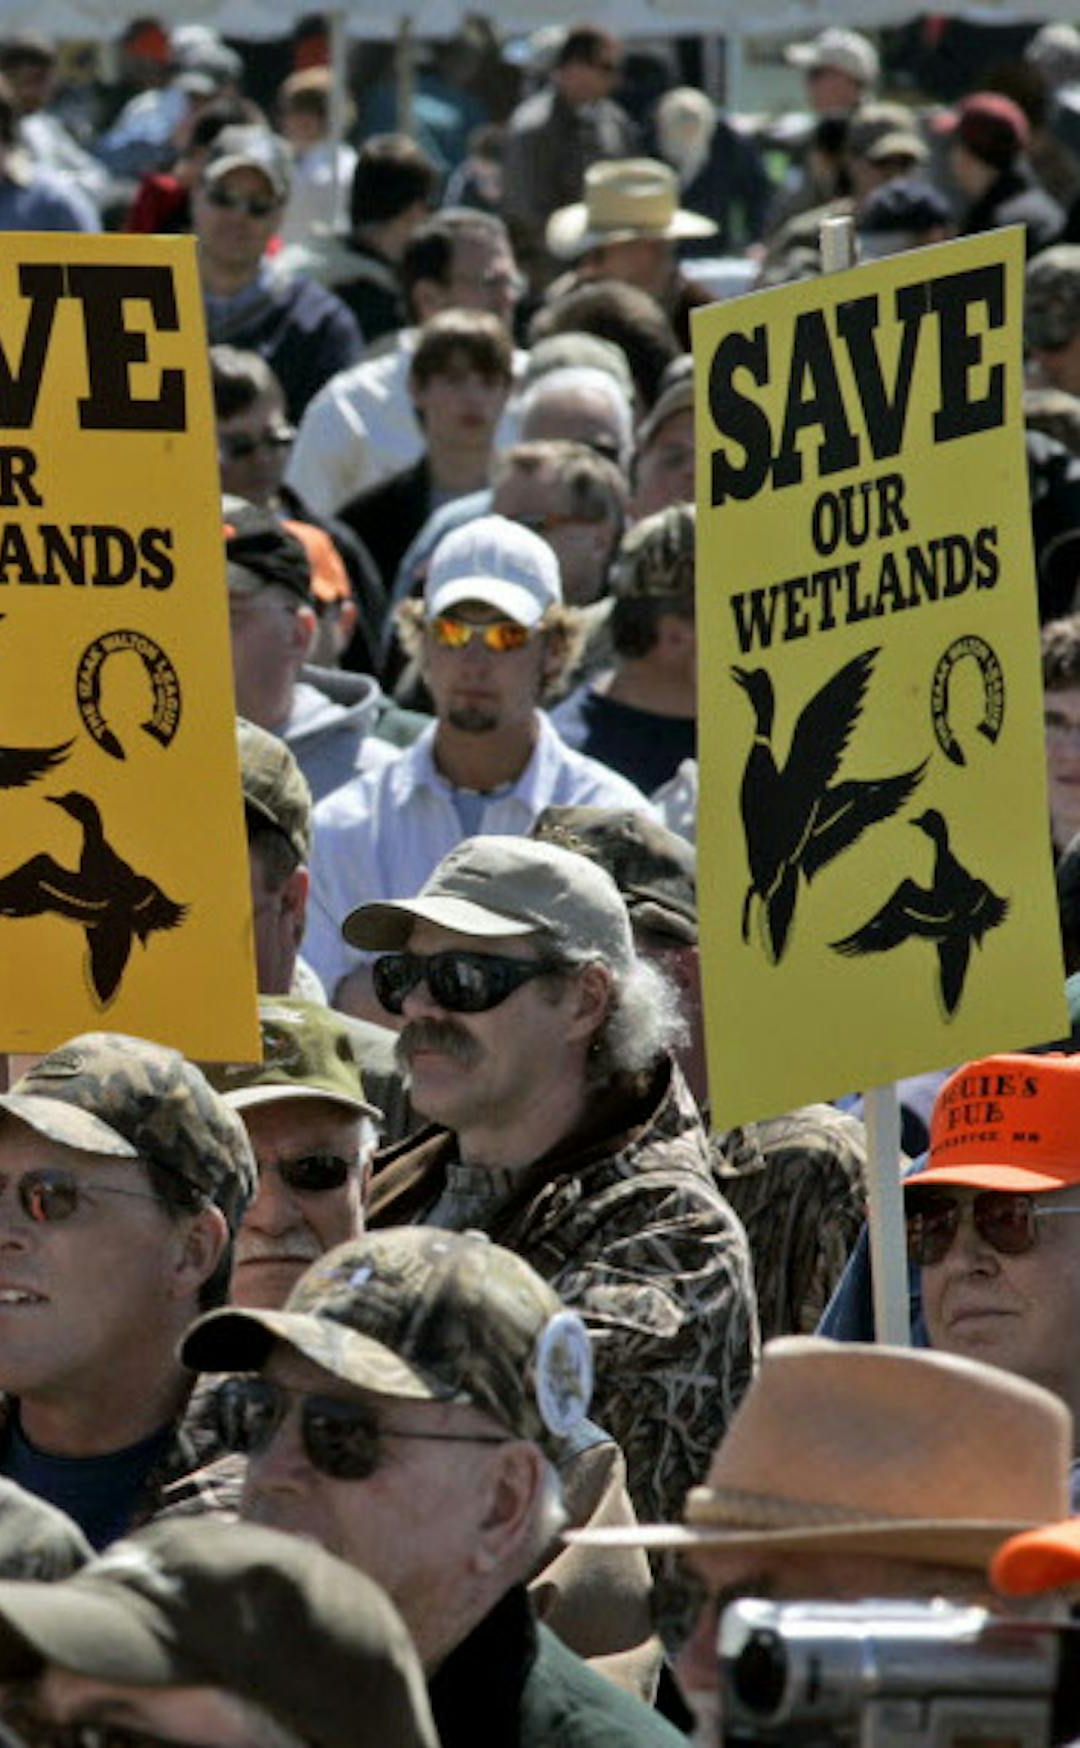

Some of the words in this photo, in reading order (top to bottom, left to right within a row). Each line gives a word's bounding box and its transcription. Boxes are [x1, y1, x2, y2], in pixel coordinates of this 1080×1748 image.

[708, 261, 1007, 507] SAVE
[811, 472, 909, 556] OUR
[730, 526, 1000, 654] WETLANDS
